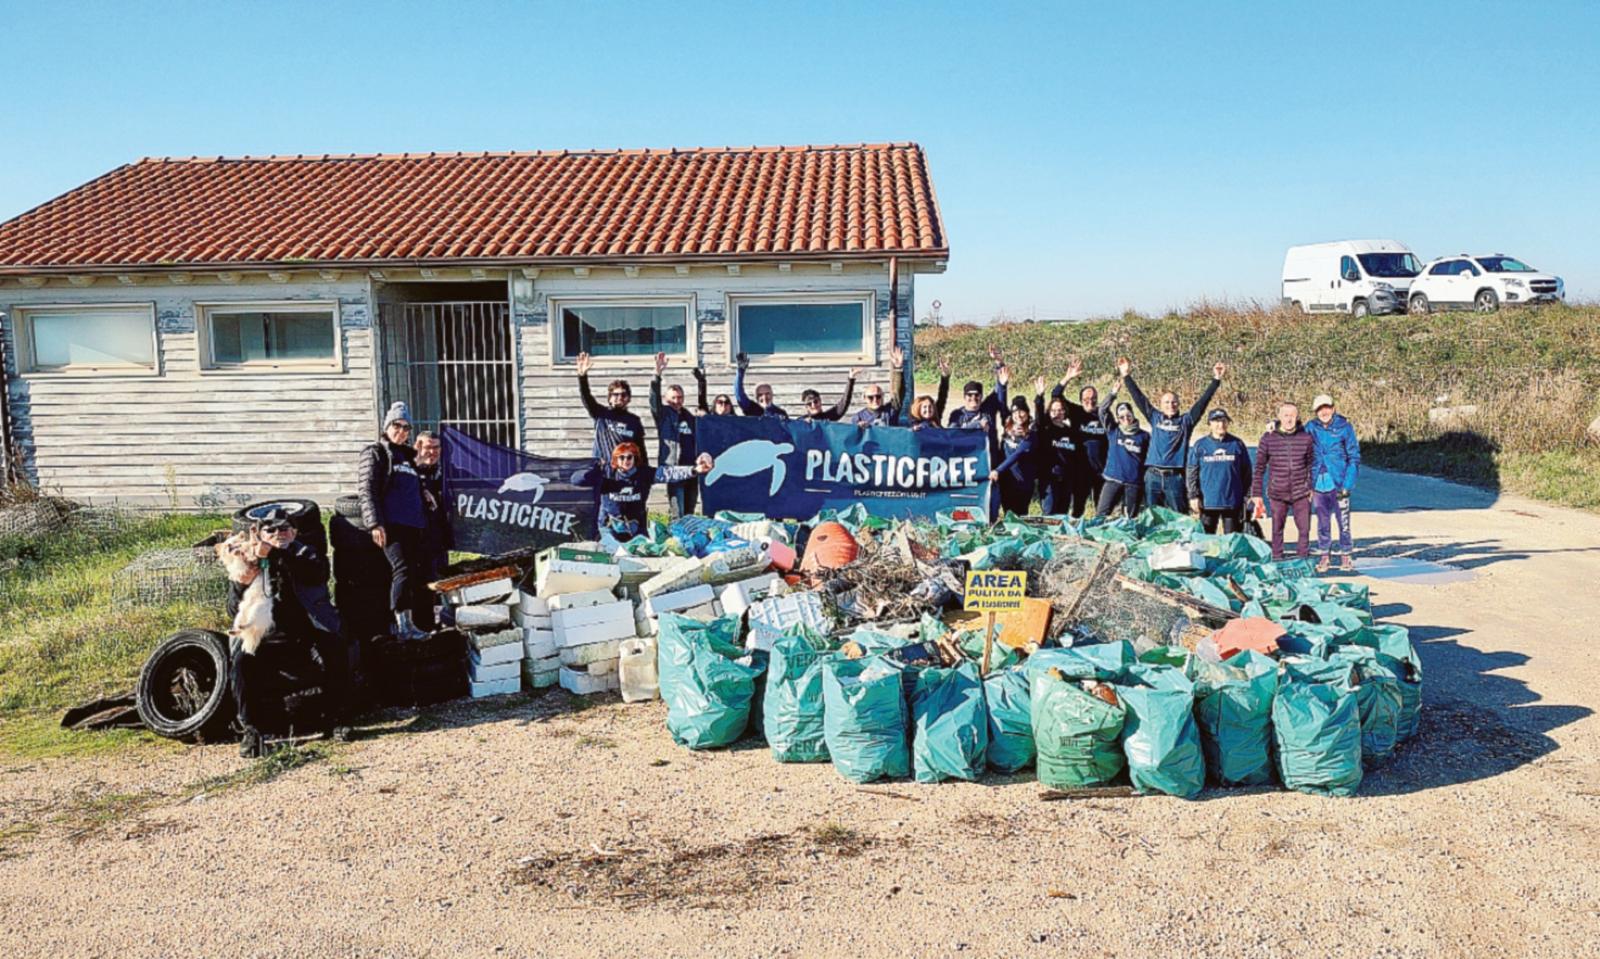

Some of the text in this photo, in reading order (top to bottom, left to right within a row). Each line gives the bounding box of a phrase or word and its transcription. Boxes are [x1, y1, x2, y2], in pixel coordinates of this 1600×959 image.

[805, 449, 978, 488] PLASTICFREE
[457, 493, 576, 536] PLASTICFREE
[968, 589, 1006, 598] PULITA
[969, 574, 1022, 588] AREA
